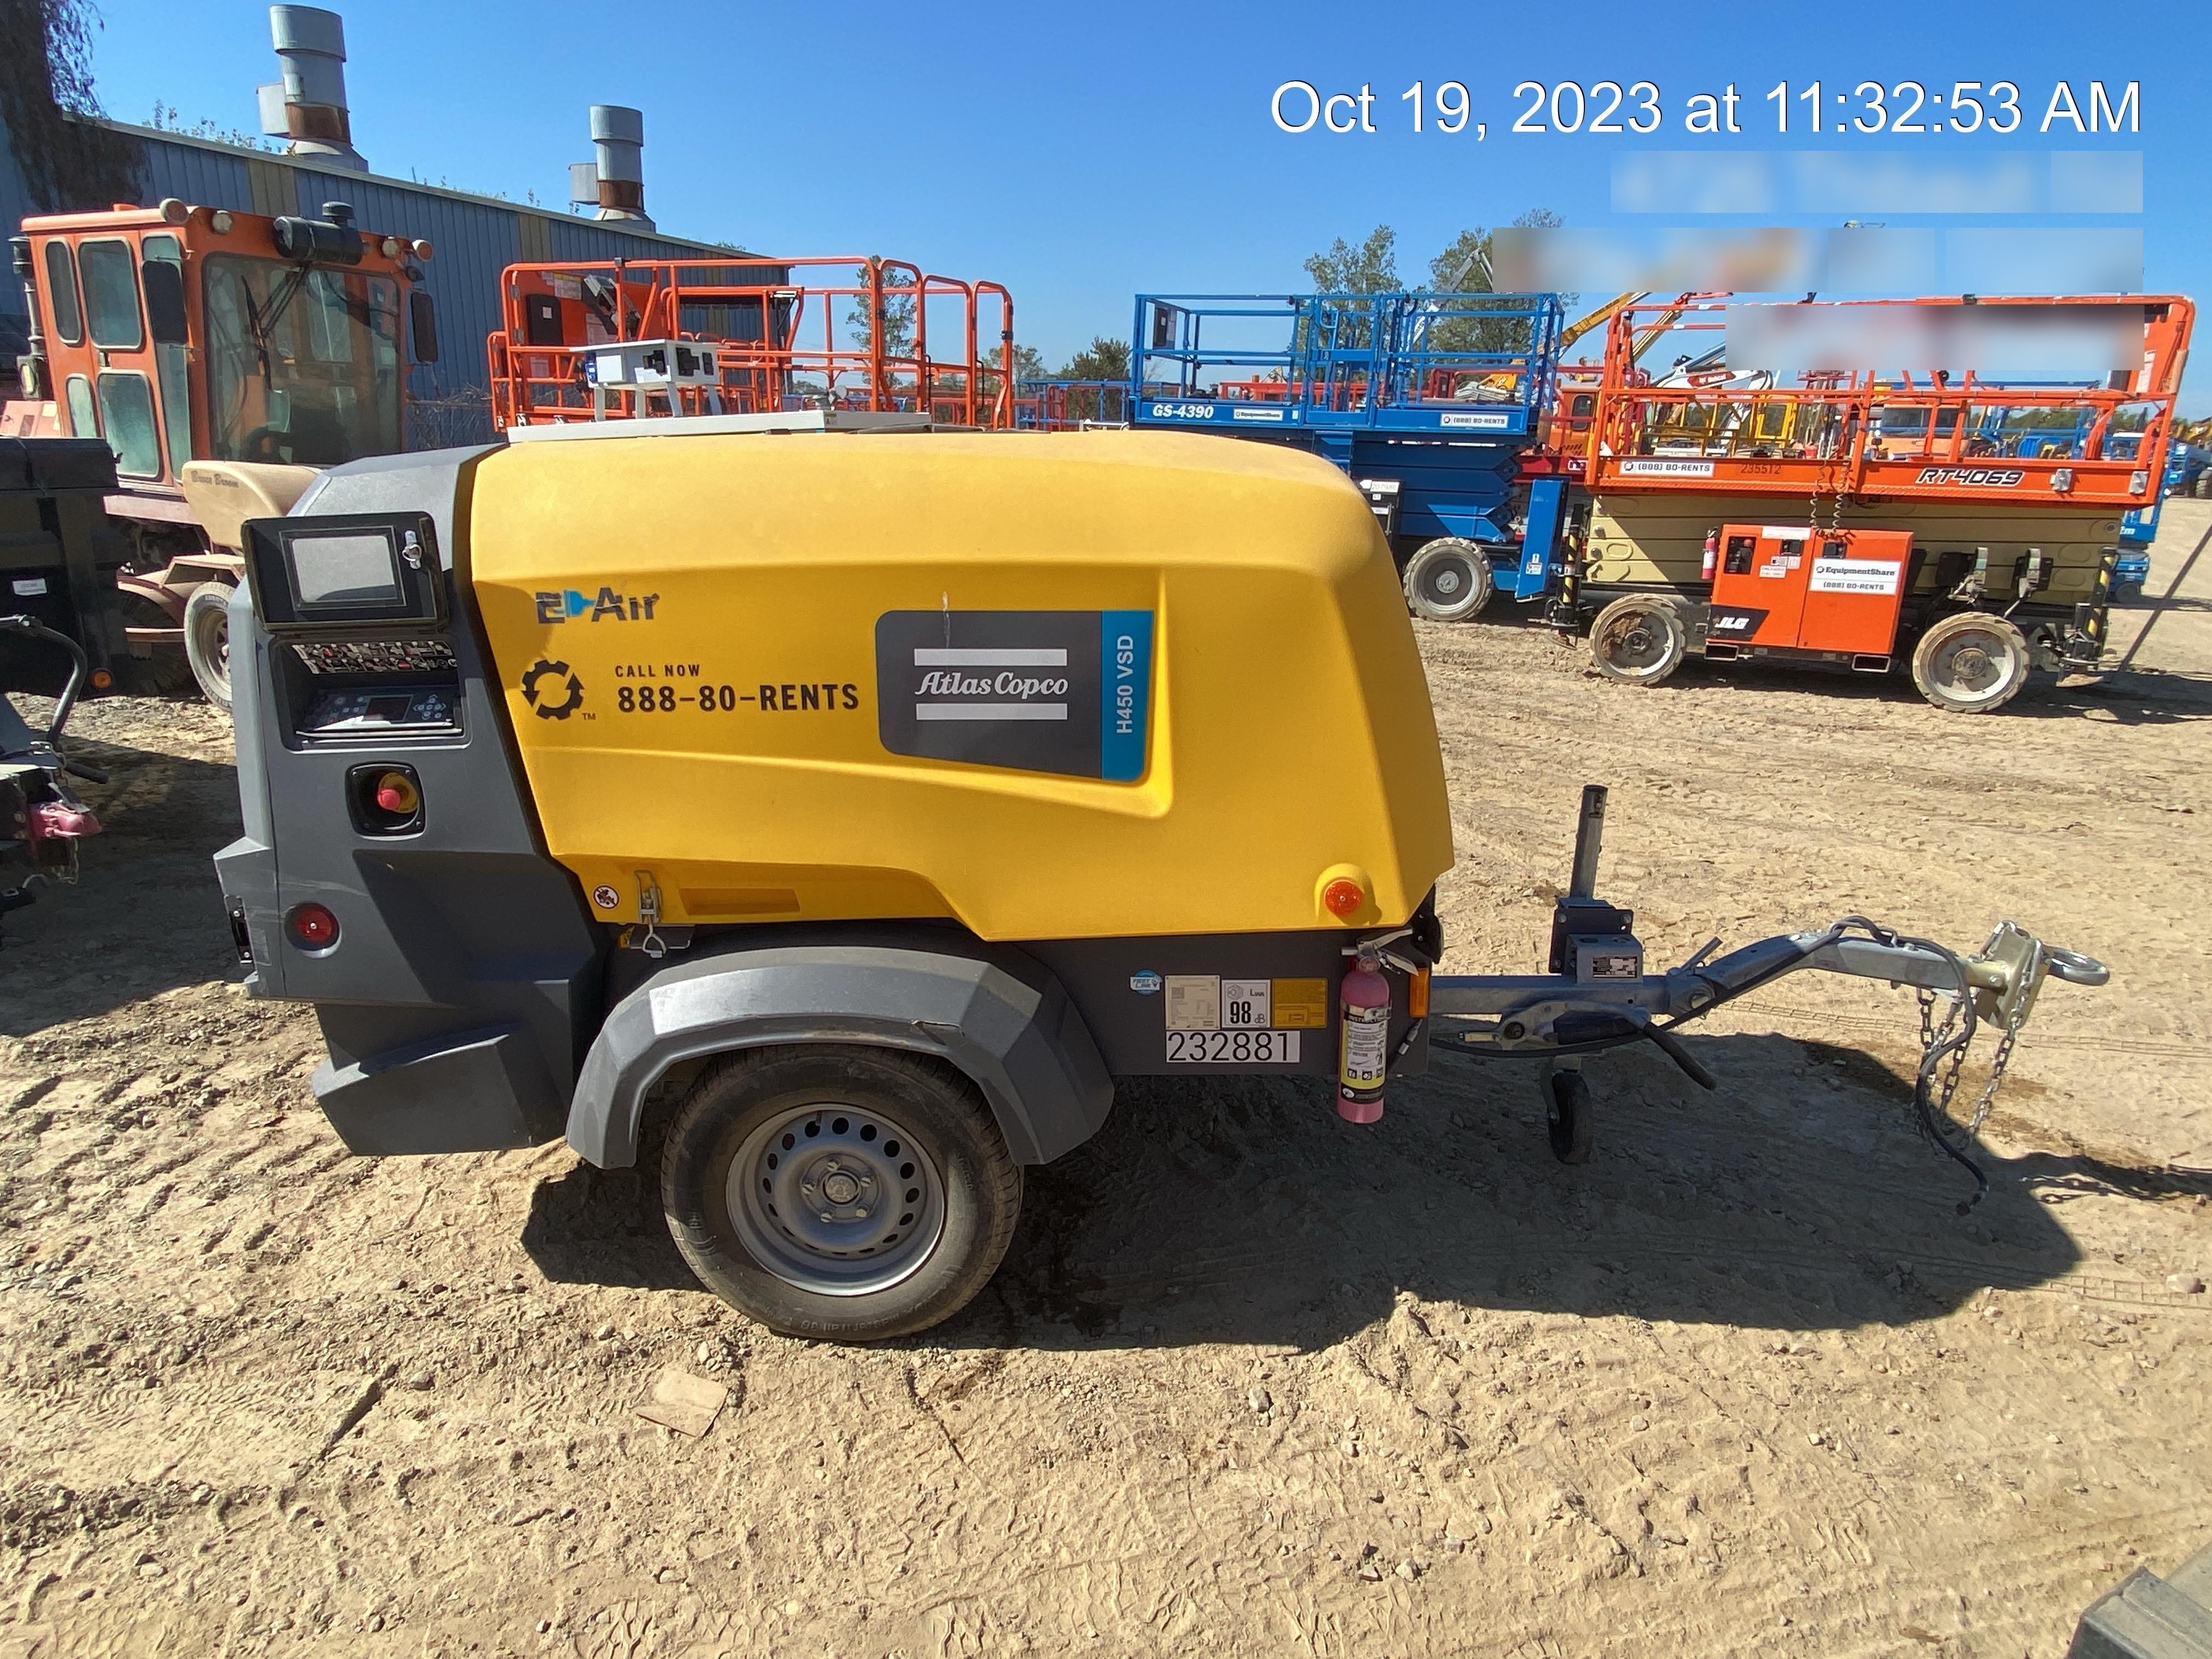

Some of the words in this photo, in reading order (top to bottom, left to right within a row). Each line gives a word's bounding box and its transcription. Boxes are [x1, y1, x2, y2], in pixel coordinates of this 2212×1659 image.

[1153, 404, 1214, 419] GS-4390
[1915, 468, 2025, 487] RT4069
[1826, 567, 1895, 575] EquipmentShare
[1714, 617, 1750, 629] JLG
[1117, 635, 1133, 679] VSD
[615, 665, 656, 678] CALL
[664, 664, 700, 677] NOW
[915, 672, 991, 695] Atlas
[994, 672, 1068, 699] Copco
[618, 683, 859, 713] 888-80-RENTS
[1116, 685, 1133, 733] H450
[1230, 1001, 1251, 1024] 98
[1254, 1013, 1265, 1024] dB
[1168, 1032, 1288, 1062] 232881
